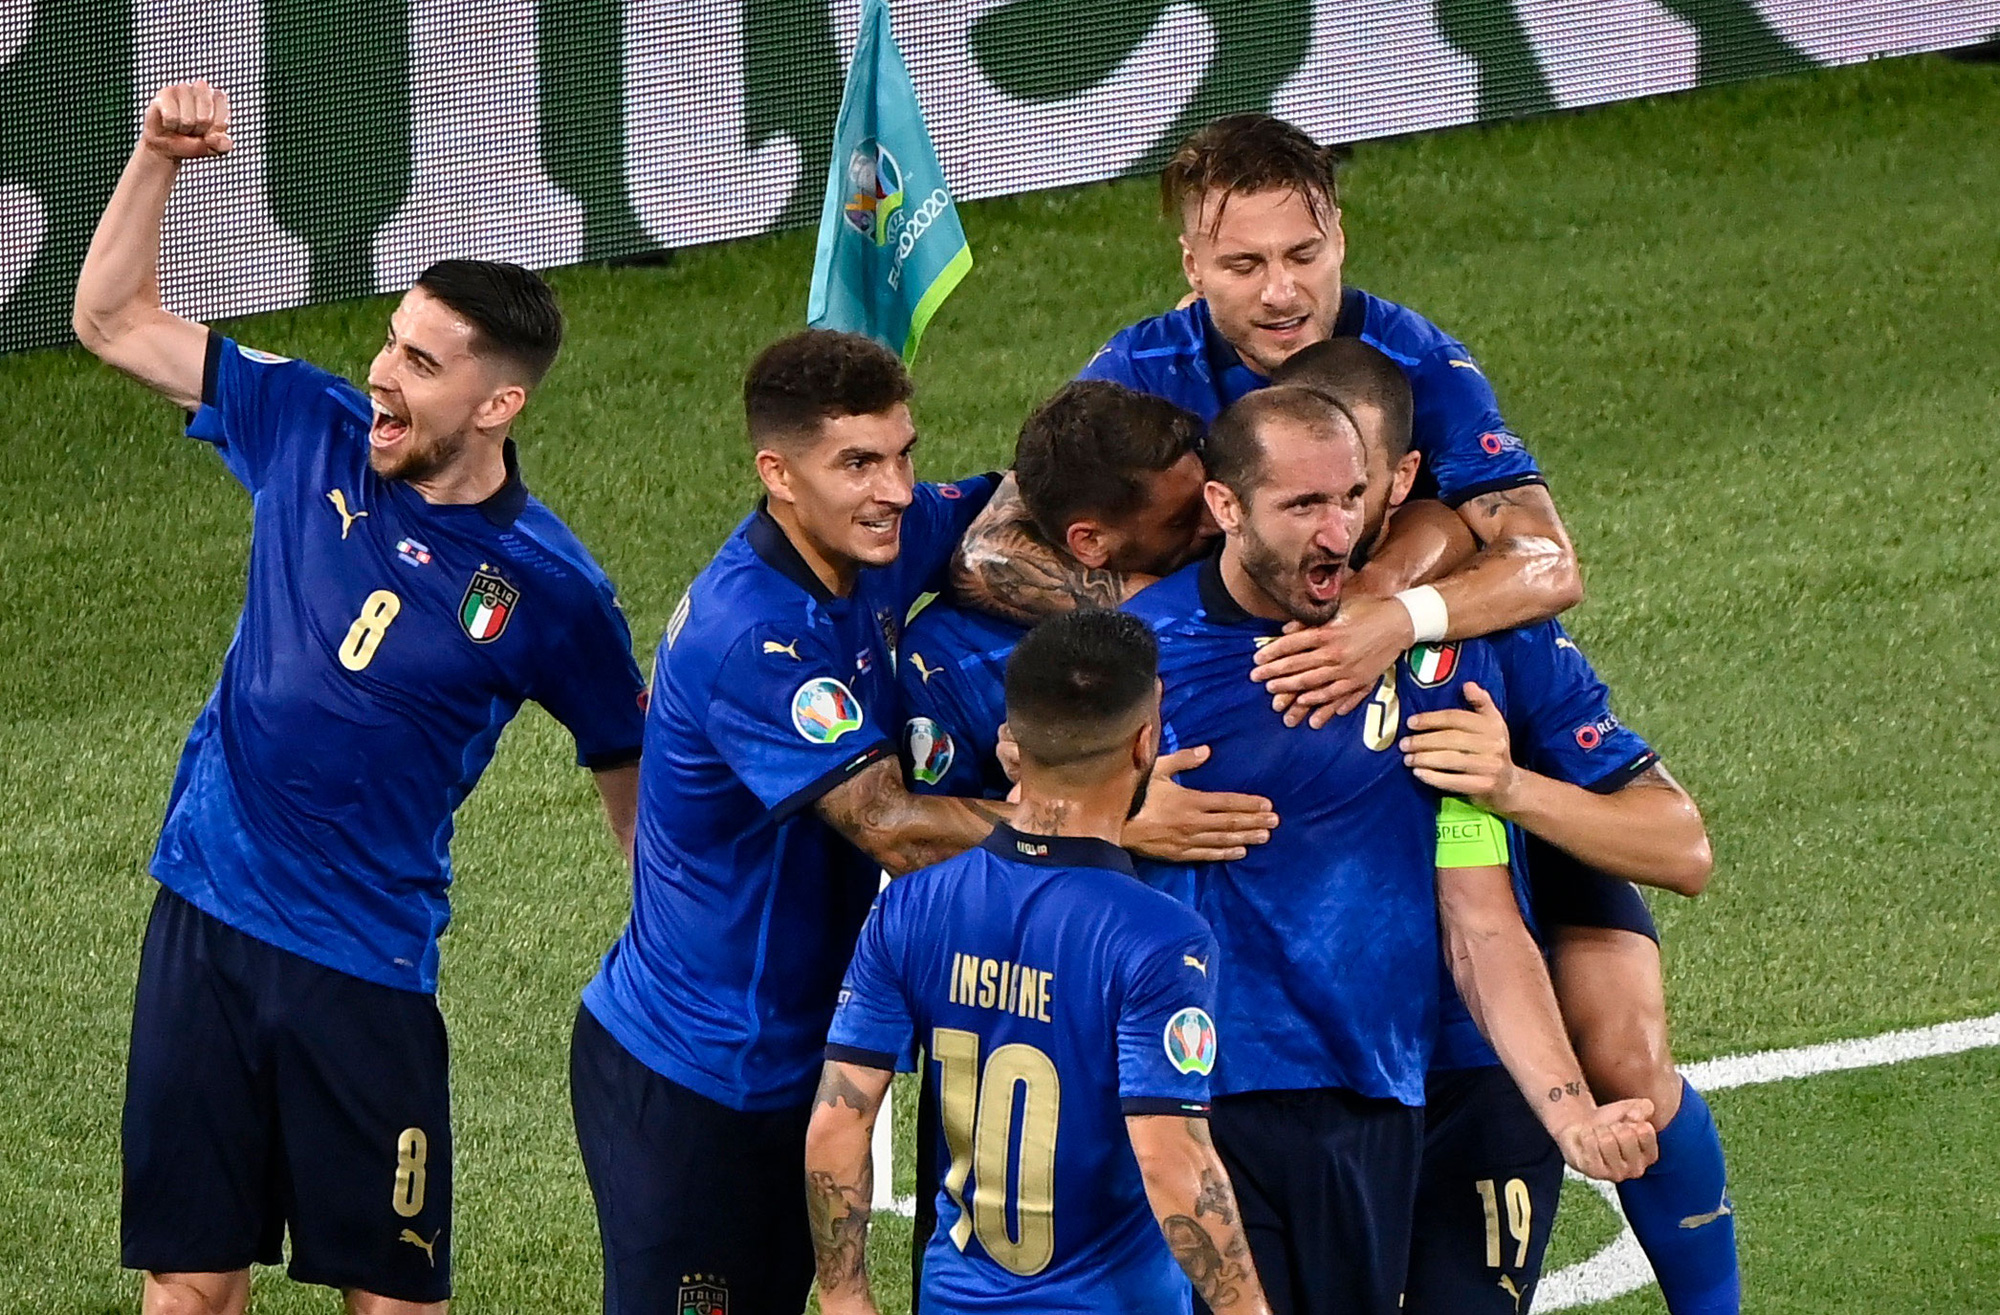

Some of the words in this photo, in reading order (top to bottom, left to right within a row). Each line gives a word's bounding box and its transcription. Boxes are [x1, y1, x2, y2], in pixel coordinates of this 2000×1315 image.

[338, 589, 401, 671] 8
[475, 578, 513, 603] ITALIA
[392, 1127, 428, 1218] 8
[932, 1027, 1060, 1276] 10
[1475, 1178, 1532, 1268] 19
